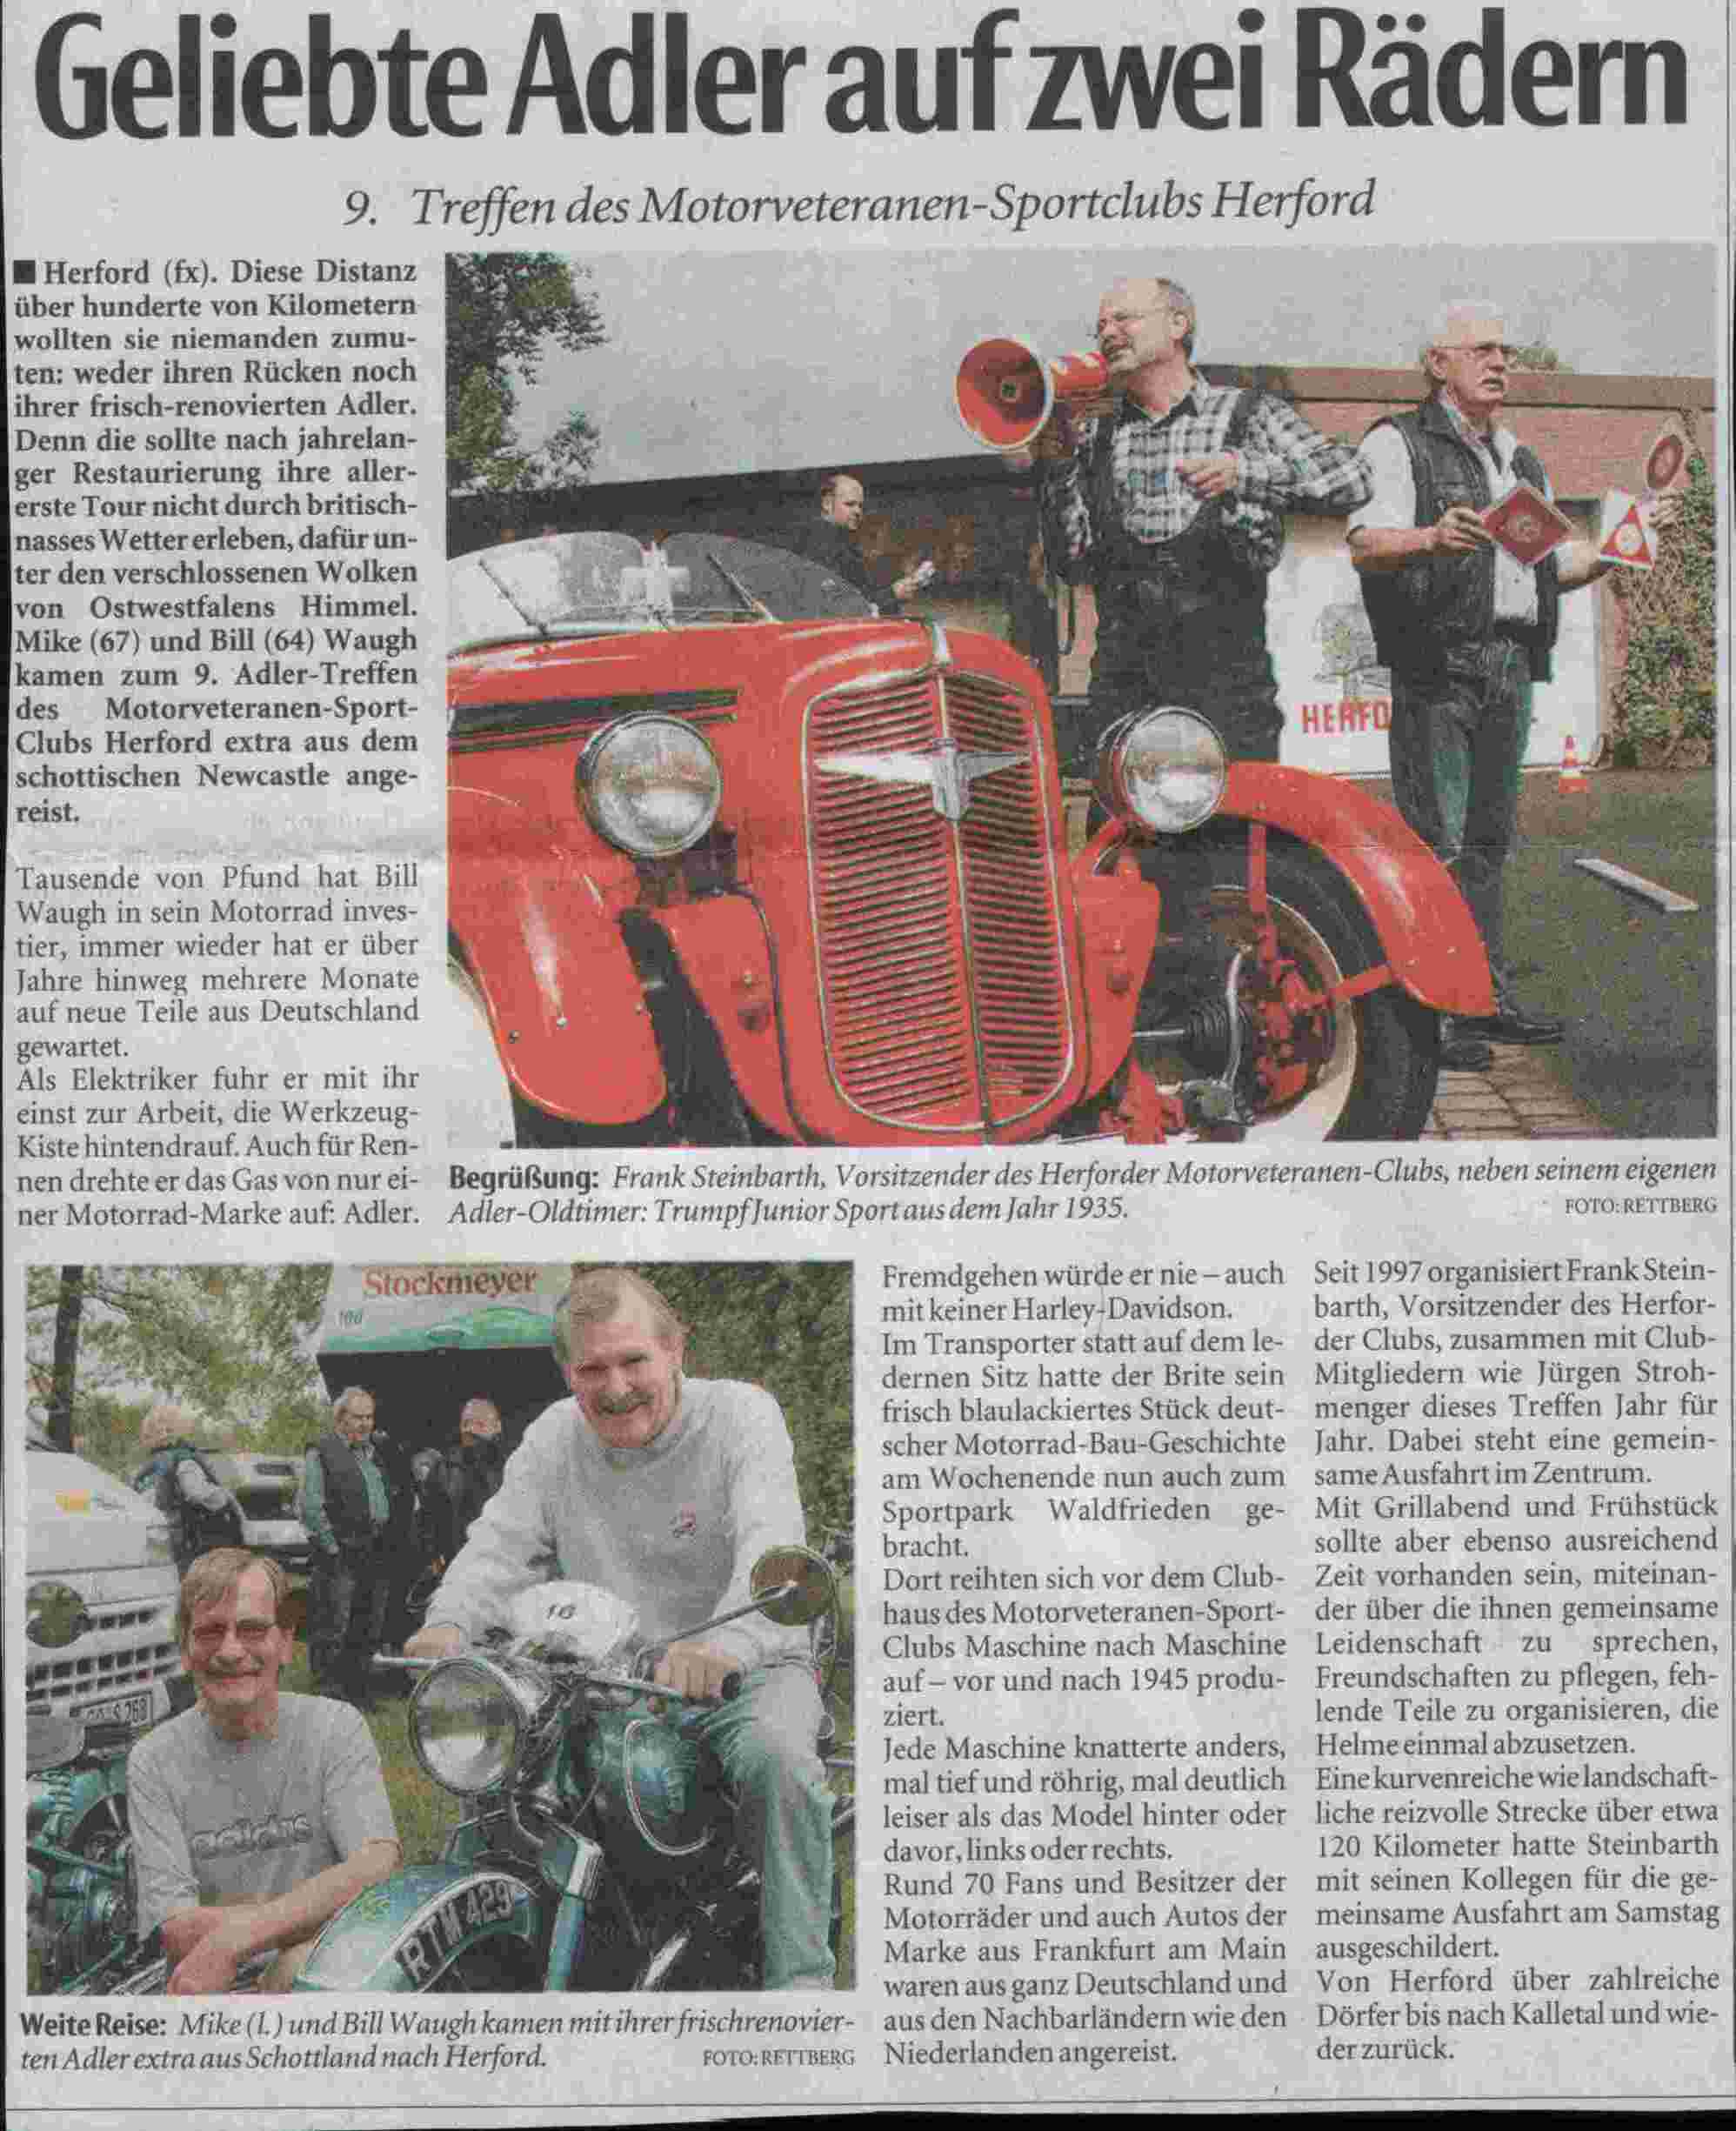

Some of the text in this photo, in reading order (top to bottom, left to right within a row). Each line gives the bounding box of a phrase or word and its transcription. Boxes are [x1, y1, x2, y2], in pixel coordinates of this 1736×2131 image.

[34, 7, 1689, 140] Geliebte Adler auf zwei Rädern
[343, 177, 1377, 237] 9. Treffen des Motorveteranen-Sportclubs Herford
[43, 257, 417, 289] Herford (fx). Diese Distanz
[13, 291, 421, 319] über hunderte von Kilometern
[13, 357, 418, 385] ten: weder ihren Rücken noch
[13, 390, 417, 418] ihrer frisch-renovierten Adler.
[13, 591, 417, 620] von Ostwestfalens Himmel.
[15, 625, 418, 658] Mike (67) und Bill (64) Waugh
[14, 862, 418, 898] Tausende von Pfund hat Bill
[15, 965, 420, 998] Jahre hinweg mehrere Monate
[13, 1037, 129, 1066] gewartet.
[16, 1064, 420, 1092] Als Elektriker fuhr er mit ihr
[449, 1154, 1717, 1197] Begrüßung: Frank Steinbarth, Vorsitzender des Herforder Motorveteranen-Clubs, neben seinem eigenen
[448, 1195, 1129, 1229] Adler-Oldtimer: Trumpf Junior Sport aus dem Jahr 1935.
[1565, 1196, 1718, 1214] FOTO: RETTBERG
[363, 1269, 537, 1299] Stockmeyer
[1314, 1289, 1716, 1321] barth, Vorsitzender des Herfor-
[881, 1359, 1285, 1390] dernen Sitz hatte der Brite sein
[1314, 1357, 1717, 1393] Mitgliedern wie Jürgen Stroh-
[882, 1394, 1285, 1424] frisch blaulackiertes Stück deut-
[883, 1495, 1285, 1531] Sportpark Waldfrieden ge-
[1314, 1491, 1719, 1520] Mit Grillabend und Frühstück
[883, 1630, 1287, 1660] Clubs Maschine nach Maschine
[1316, 1627, 1719, 1660] Leidenschaft zu sprechen,
[883, 1732, 1286, 1763] Jede Maschine knatterte anders,
[1319, 1830, 1719, 1859] 120 Kilometer hatte Steinbarth
[884, 1867, 1288, 1897] Rund 70 Fans und Besitzer der
[884, 1935, 1286, 1964] Marke aus Frankfurt am Main
[1316, 1964, 1719, 1993] Von Herford über zahlreiche
[20, 2011, 92, 2036] Weite
[95, 2011, 168, 2036] Reise:
[179, 2011, 242, 2036] Mike
[289, 2010, 338, 2035] und
[340, 2010, 384, 2035] Bill
[389, 2009, 477, 2041] Waugh
[481, 2009, 564, 2035] kamen
[569, 2008, 614, 2034] mit
[615, 2008, 676, 2034] ihrer
[674, 2007, 856, 2040] frischrenovier-
[21, 2041, 547, 2074] ten Adler extra aus Schottland nach Herford.
[703, 2048, 855, 2067] FOTO: RETTBERG
